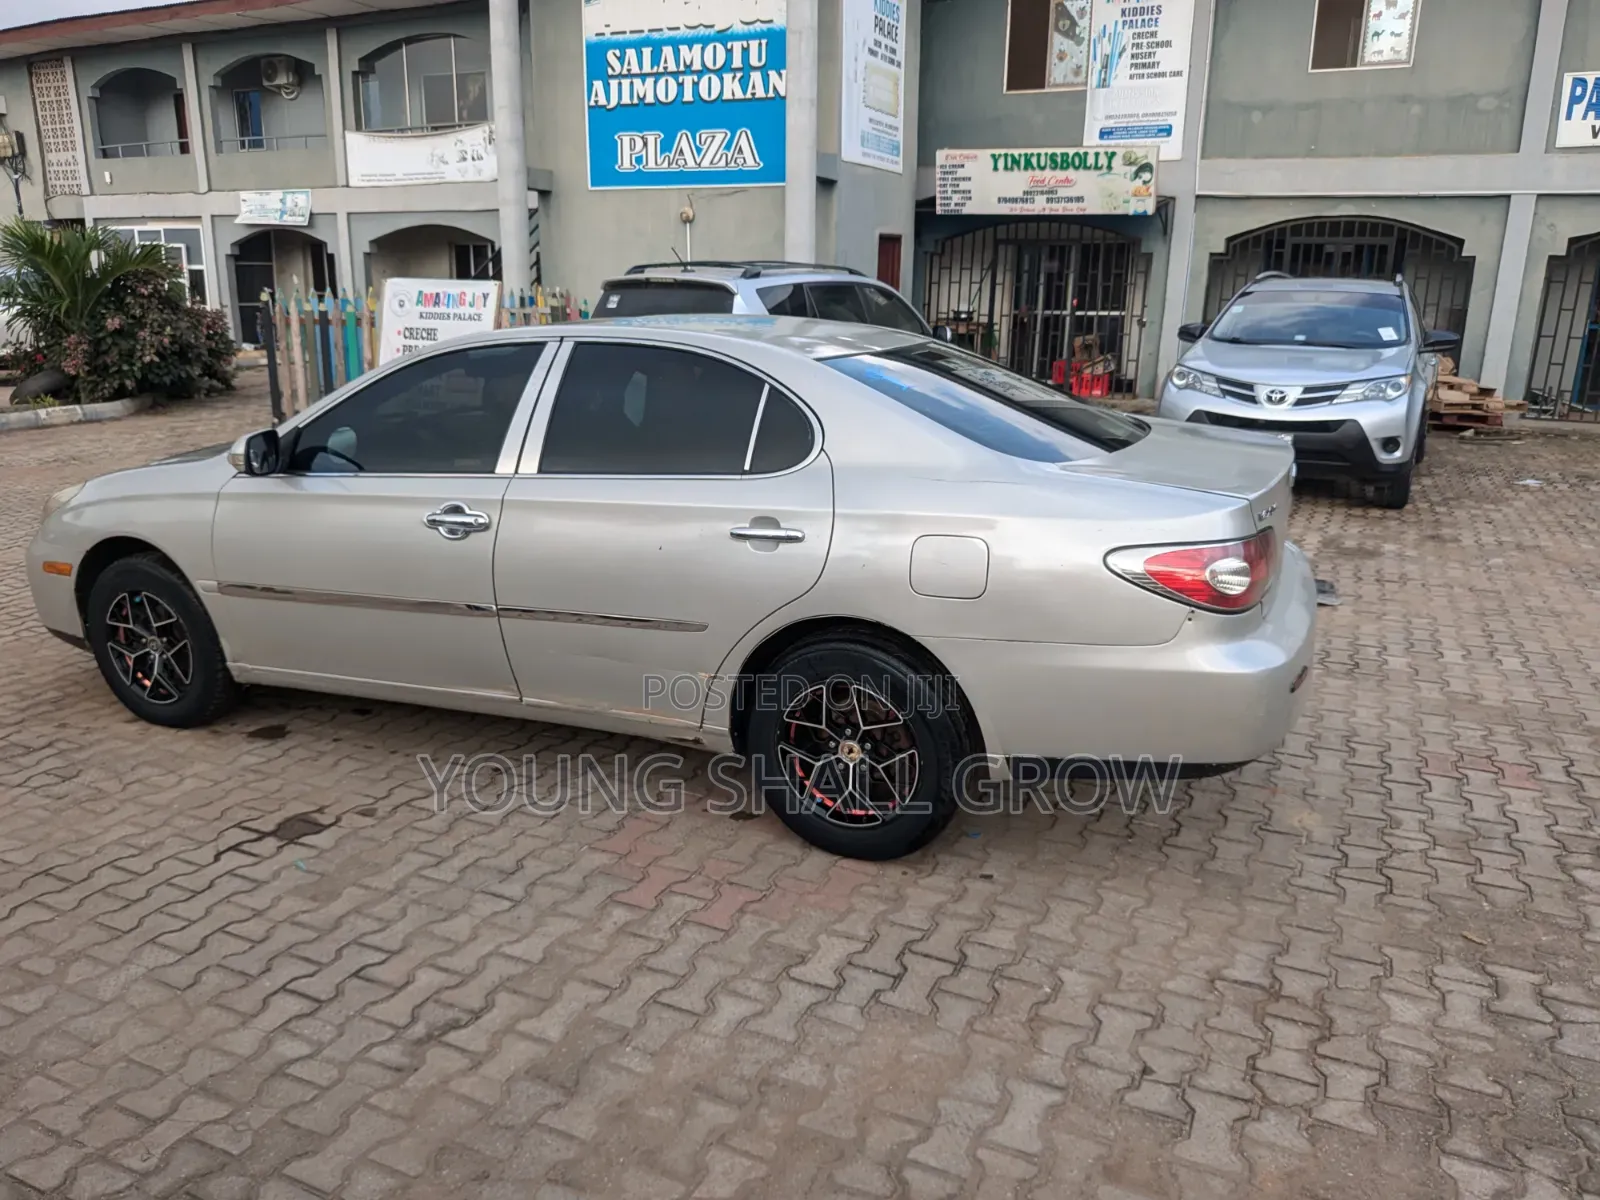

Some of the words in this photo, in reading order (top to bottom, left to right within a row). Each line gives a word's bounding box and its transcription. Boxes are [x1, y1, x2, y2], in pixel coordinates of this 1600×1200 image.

[1121, 5, 1162, 18] KIDDIES
[874, 16, 898, 44] PALACE
[1122, 17, 1159, 30] PALACE
[1132, 31, 1158, 40] CRECHE
[1131, 40, 1172, 51] PRE-SCHOOL
[606, 39, 768, 76] SALAMOTU
[1130, 51, 1157, 60] NUSERY
[1130, 61, 1160, 71] PRIMARY
[1169, 70, 1183, 78] CARE
[588, 69, 786, 110] AJIMOTOKAN
[1565, 77, 1600, 120] PA
[616, 128, 762, 172] PLAZA
[990, 151, 1117, 172] YINKUSBOLLY
[415, 290, 467, 309] AMAZING
[469, 292, 490, 310] JOY
[418, 312, 451, 320] KIDDIES
[453, 312, 483, 321] PALACE
[403, 327, 439, 341] CRECHE
